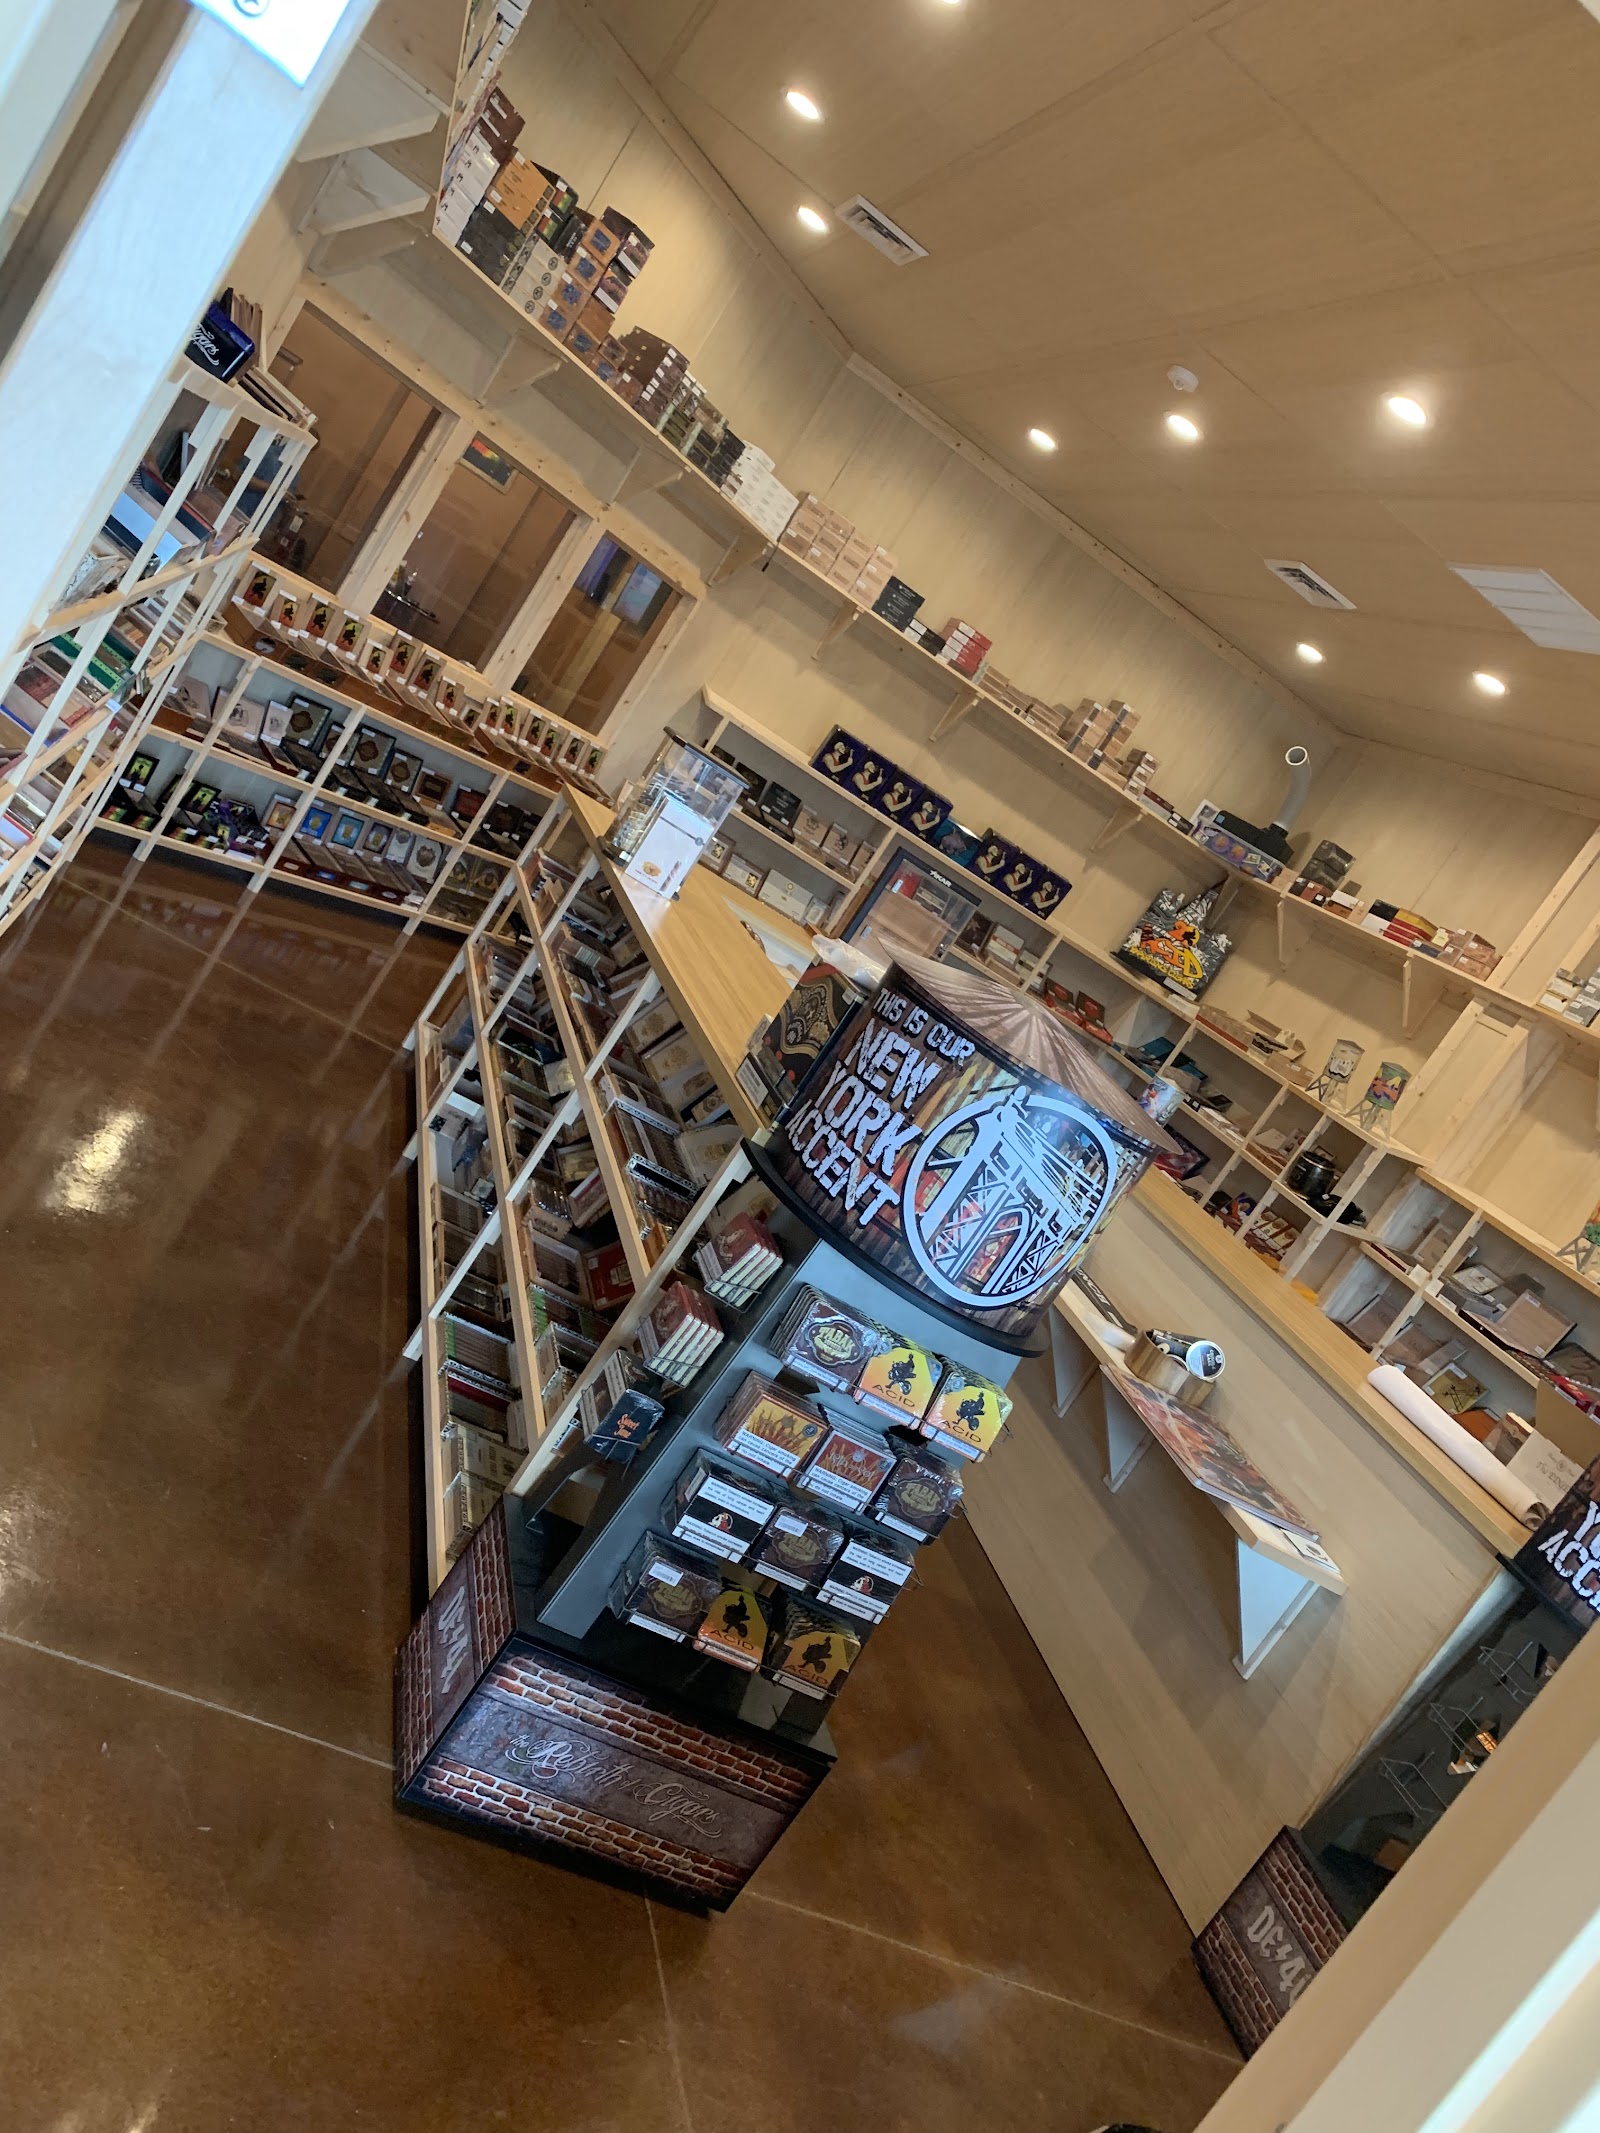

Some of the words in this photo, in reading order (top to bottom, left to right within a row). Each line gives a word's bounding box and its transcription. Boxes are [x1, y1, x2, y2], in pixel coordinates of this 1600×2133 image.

[873, 988, 907, 1023] THIS
[903, 1006, 928, 1034] IS
[927, 1023, 975, 1066] OUR
[844, 1018, 941, 1109] NEW
[815, 1061, 922, 1176] YORK
[785, 1099, 900, 1225] ACCENT
[819, 1327, 855, 1351] TABAK
[872, 1383, 915, 1408] ACID
[942, 1419, 982, 1443] ACID
[837, 1478, 849, 1487] Cigar
[709, 1629, 755, 1651] ACID
[785, 1663, 829, 1686] ACID
[509, 1735, 529, 1751] the
[505, 1739, 634, 1787] Rebirth
[634, 1782, 723, 1838] Cigars
